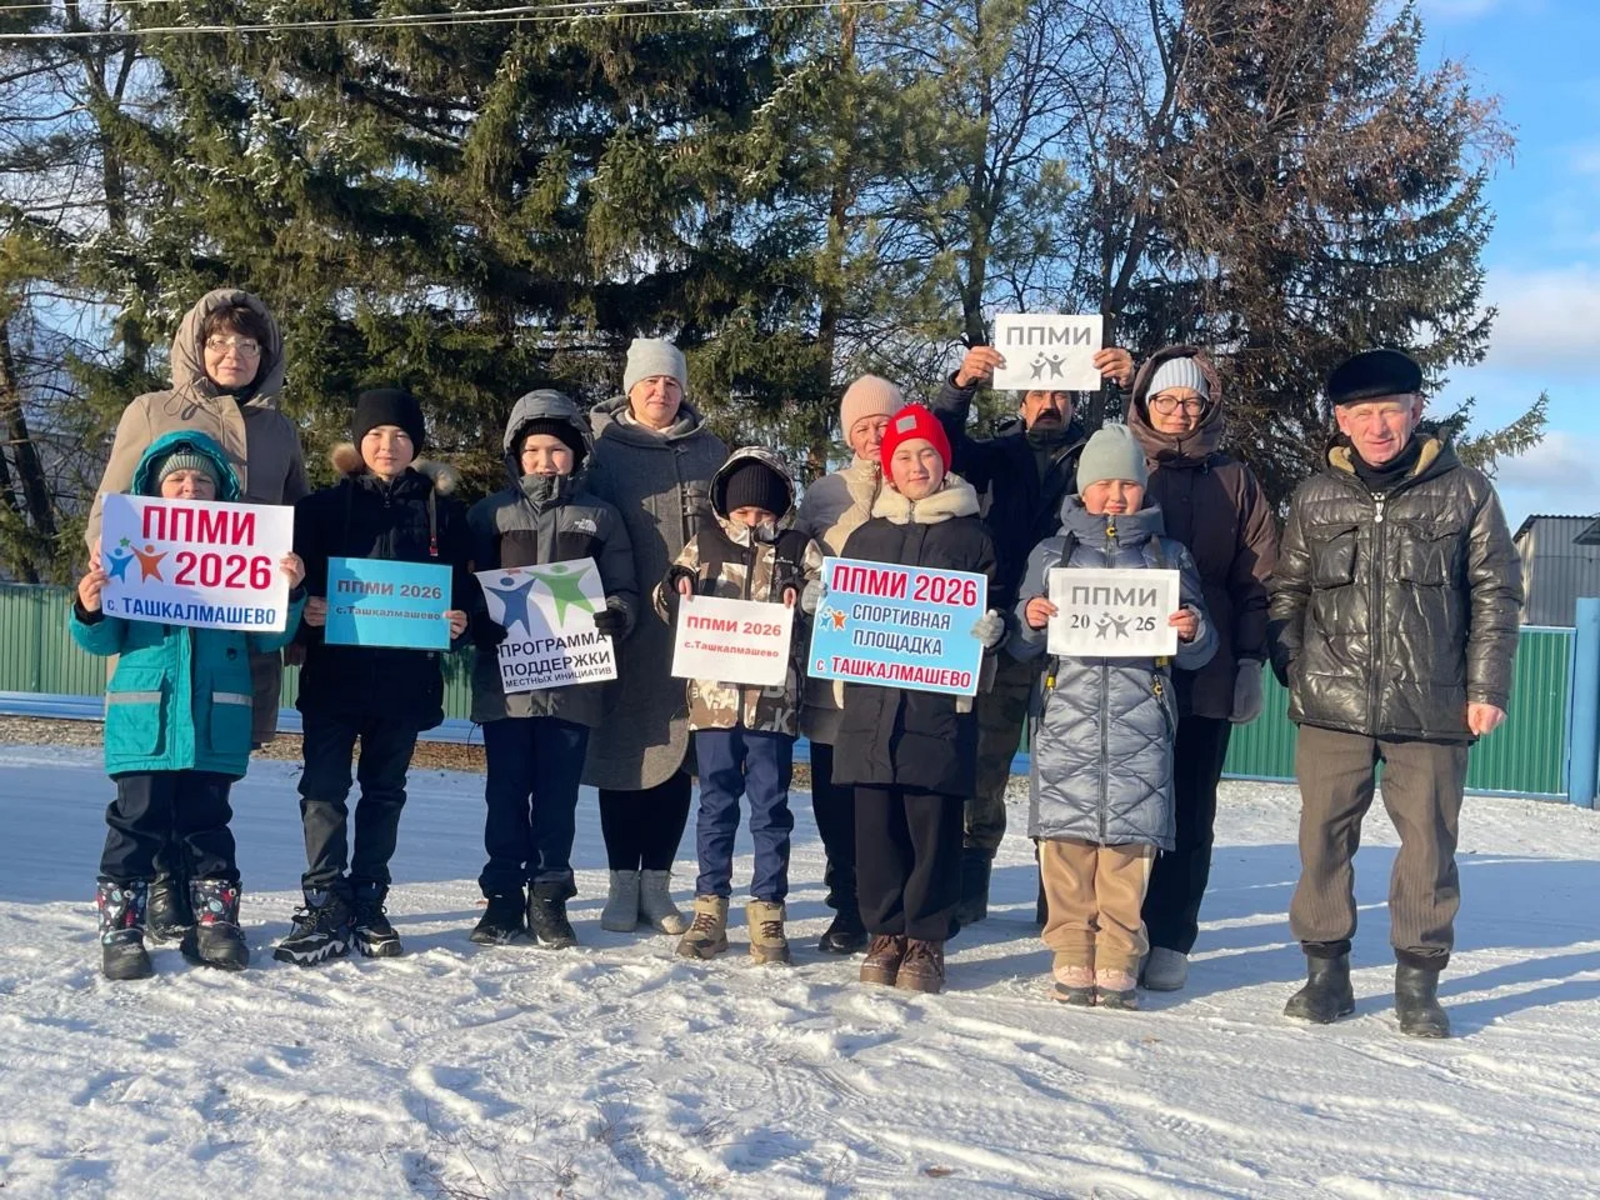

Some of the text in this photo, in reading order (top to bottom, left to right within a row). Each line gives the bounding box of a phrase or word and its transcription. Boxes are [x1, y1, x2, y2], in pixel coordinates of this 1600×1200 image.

[1006, 326, 1091, 346] ППМИ
[142, 505, 256, 546] ППМИ
[174, 551, 272, 590] 2026
[336, 579, 442, 600] ППМИ 2026
[832, 565, 978, 607] ППМИ 2026
[1072, 586, 1157, 607] ППМИ
[123, 597, 276, 625] ТАШКАЛМАШЕВО
[336, 605, 441, 621] с.Ташкалмашево
[852, 604, 951, 631] СПОРТИВНАЯ
[1070, 613, 1091, 630] 20
[686, 615, 782, 637] ППМИ 2026
[500, 632, 607, 658] ПРОГРАММА
[684, 640, 779, 658] с.Ташкалмашево
[853, 630, 943, 656] ПЛОЩАДКА
[502, 651, 611, 677] ПОДДЕРЖКИ
[505, 666, 612, 688] МЕСТНЫХ ИНИЦИАТИВ
[832, 657, 972, 689] ТАШКАЛМАШЕВО
